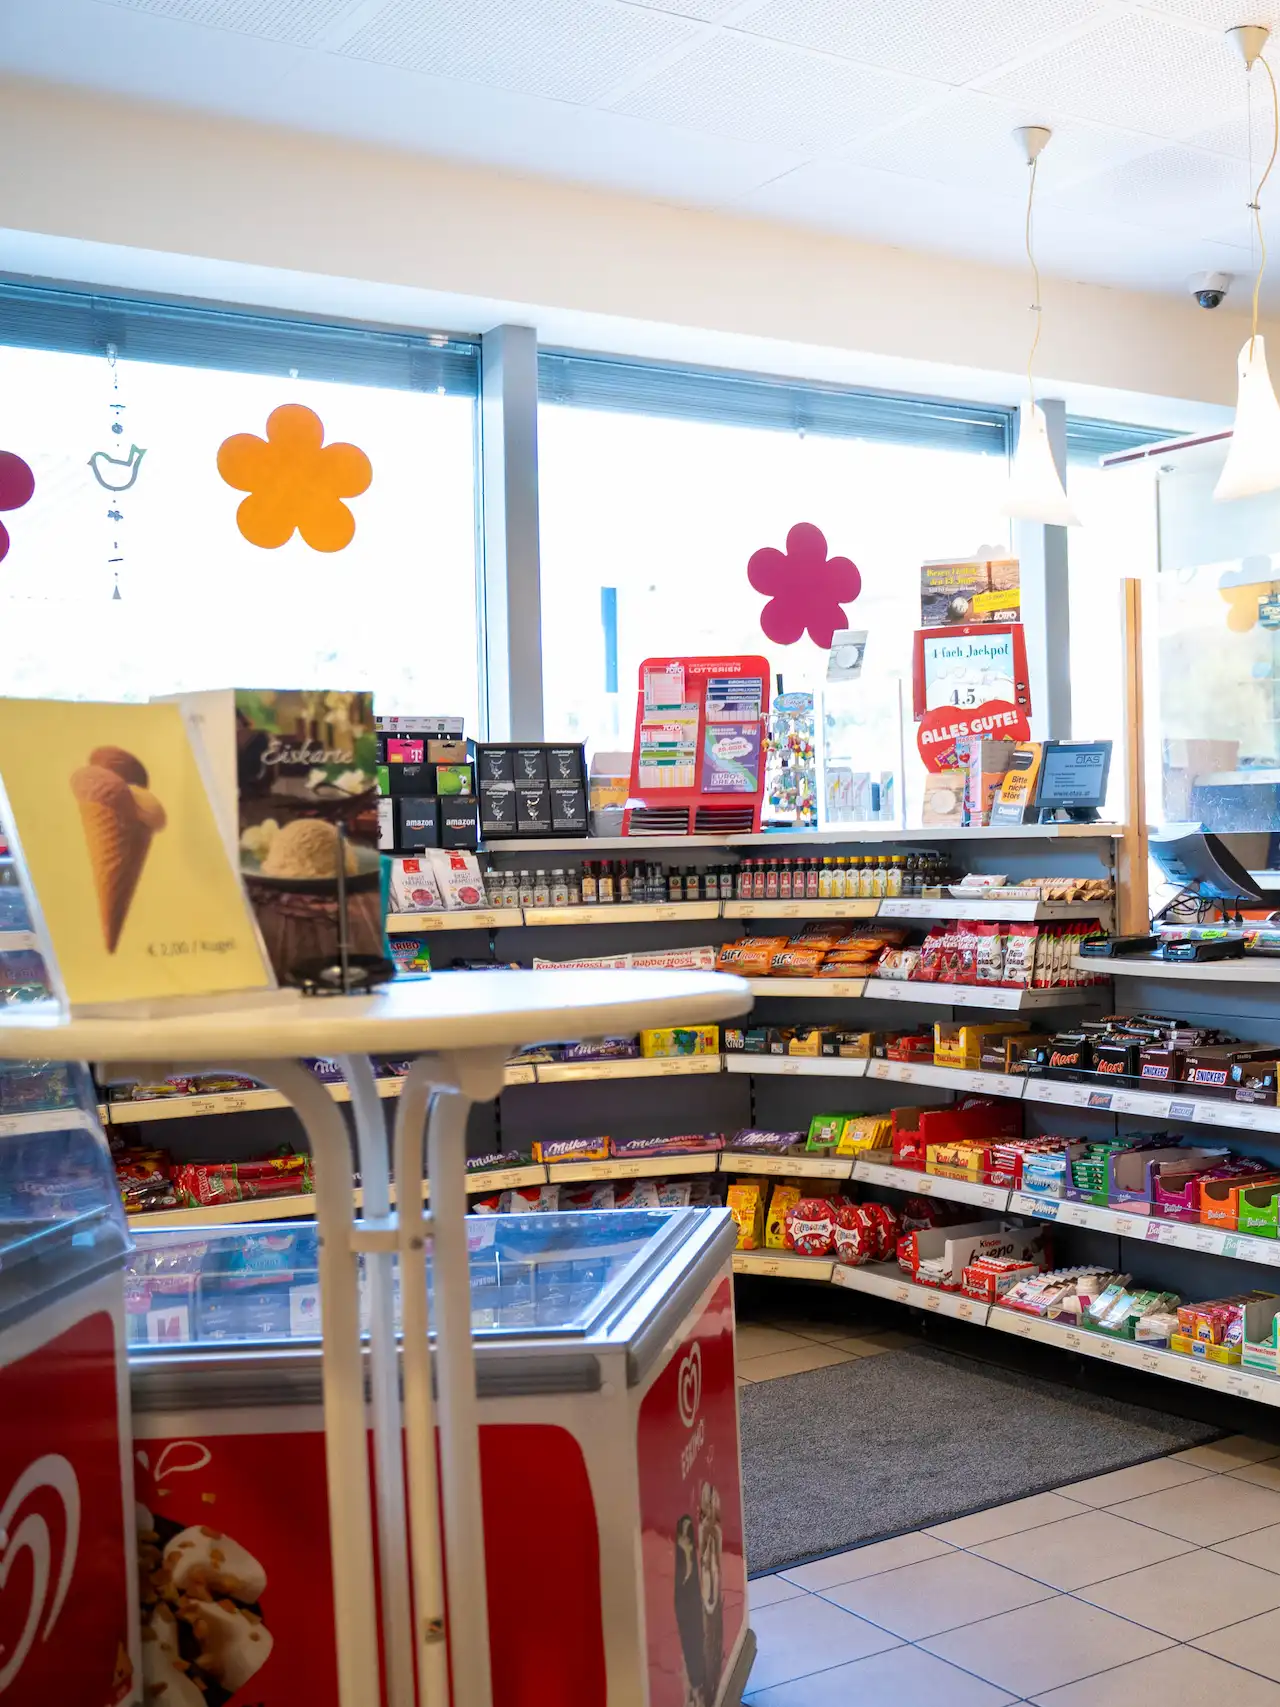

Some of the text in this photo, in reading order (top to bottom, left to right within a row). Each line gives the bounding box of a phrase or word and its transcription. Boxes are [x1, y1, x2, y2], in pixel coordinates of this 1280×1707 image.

[966, 643, 1009, 659] Jackpot
[688, 666, 742, 674] LOTTERIEN
[920, 710, 1019, 746] ALLES GUTE!
[405, 818, 434, 828] amazon
[446, 818, 476, 827] amazon
[725, 1039, 744, 1048] KIND
[1049, 1050, 1079, 1067] Mars
[1096, 1058, 1125, 1074] Mars
[1143, 1066, 1168, 1077] SNICKERS
[1188, 1068, 1227, 1083] 2 SNICKERS
[743, 1131, 780, 1145] Milka
[548, 1140, 588, 1156] Milka
[466, 1154, 505, 1168] Milka
[969, 1243, 1014, 1265] bueno
